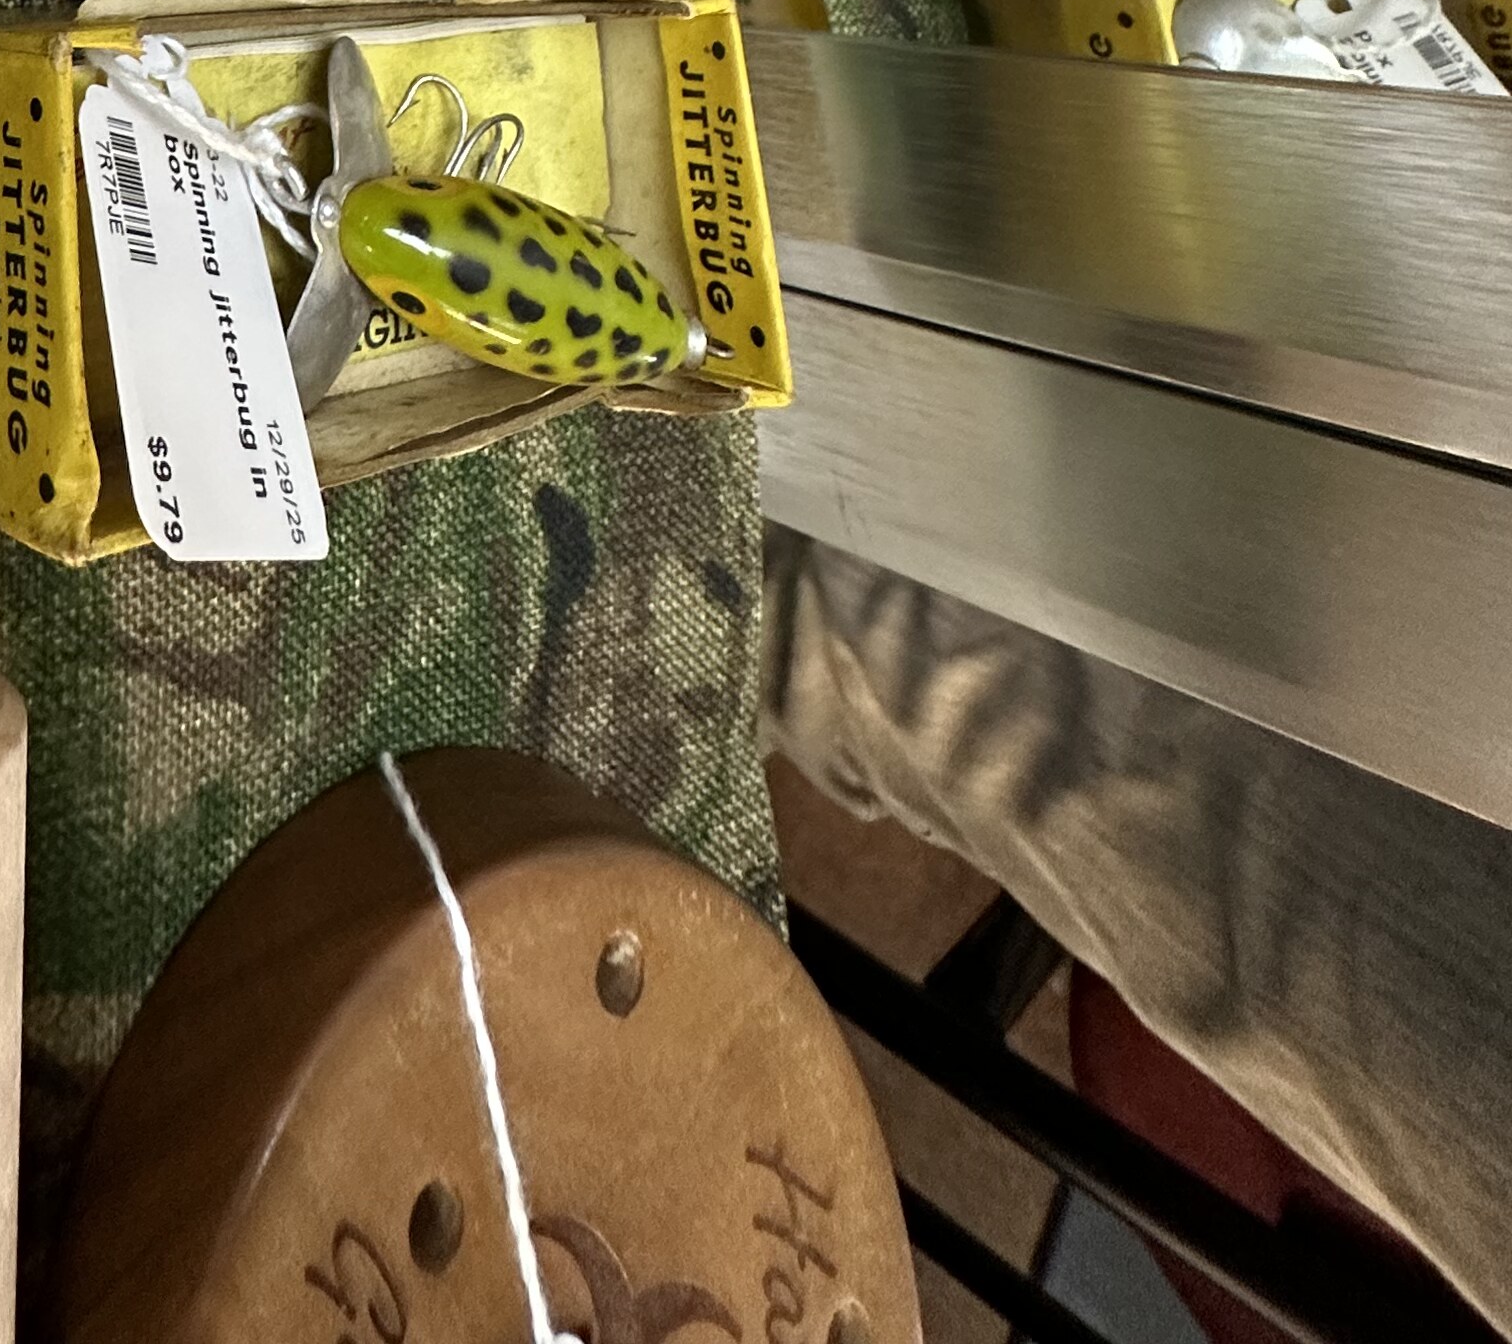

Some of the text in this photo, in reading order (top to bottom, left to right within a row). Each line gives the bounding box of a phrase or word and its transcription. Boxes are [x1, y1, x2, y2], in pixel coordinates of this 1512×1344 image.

[95, 139, 125, 236] 7R7PJE
[163, 132, 186, 193] box
[679, 59, 735, 316] JITTERBUG
[713, 106, 754, 278] Spinning
[1, 121, 29, 456] JITTERBUG
[26, 180, 55, 409] Spinning
[182, 139, 269, 500] Spinning jitterbug in
[207, 149, 307, 546] 3-22 12/29/25
[147, 435, 185, 544] $9.79
